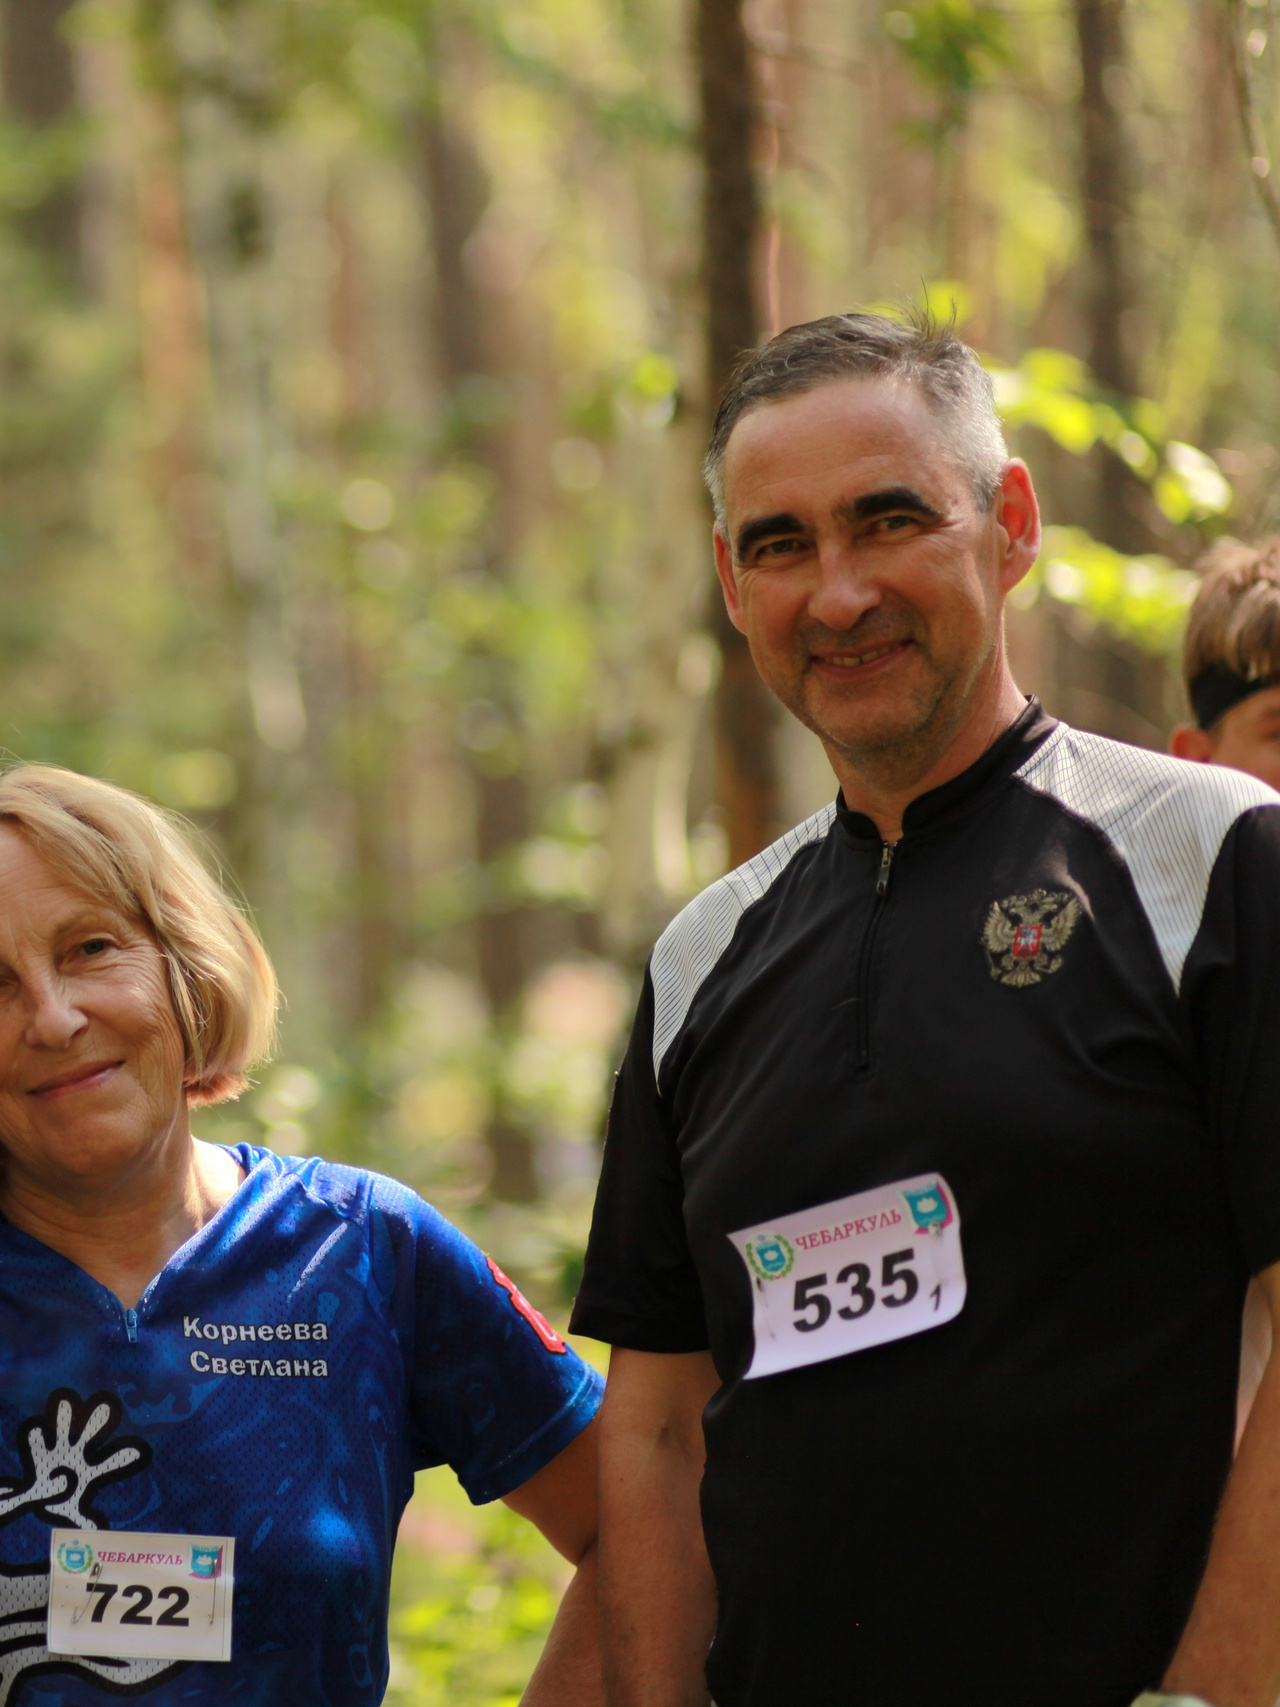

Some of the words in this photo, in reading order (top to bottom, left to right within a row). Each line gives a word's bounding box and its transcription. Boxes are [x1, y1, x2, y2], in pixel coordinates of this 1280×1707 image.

[795, 1209, 902, 1251] ЧЕБАРКУЛЬ
[793, 1247, 919, 1333] 535
[930, 1284, 941, 1312] 1
[183, 1315, 329, 1345] Корнеева
[190, 1350, 329, 1377] Светлана
[97, 1551, 183, 1566] ЧЕБАРКУЛЬ
[86, 1582, 190, 1627] 722
